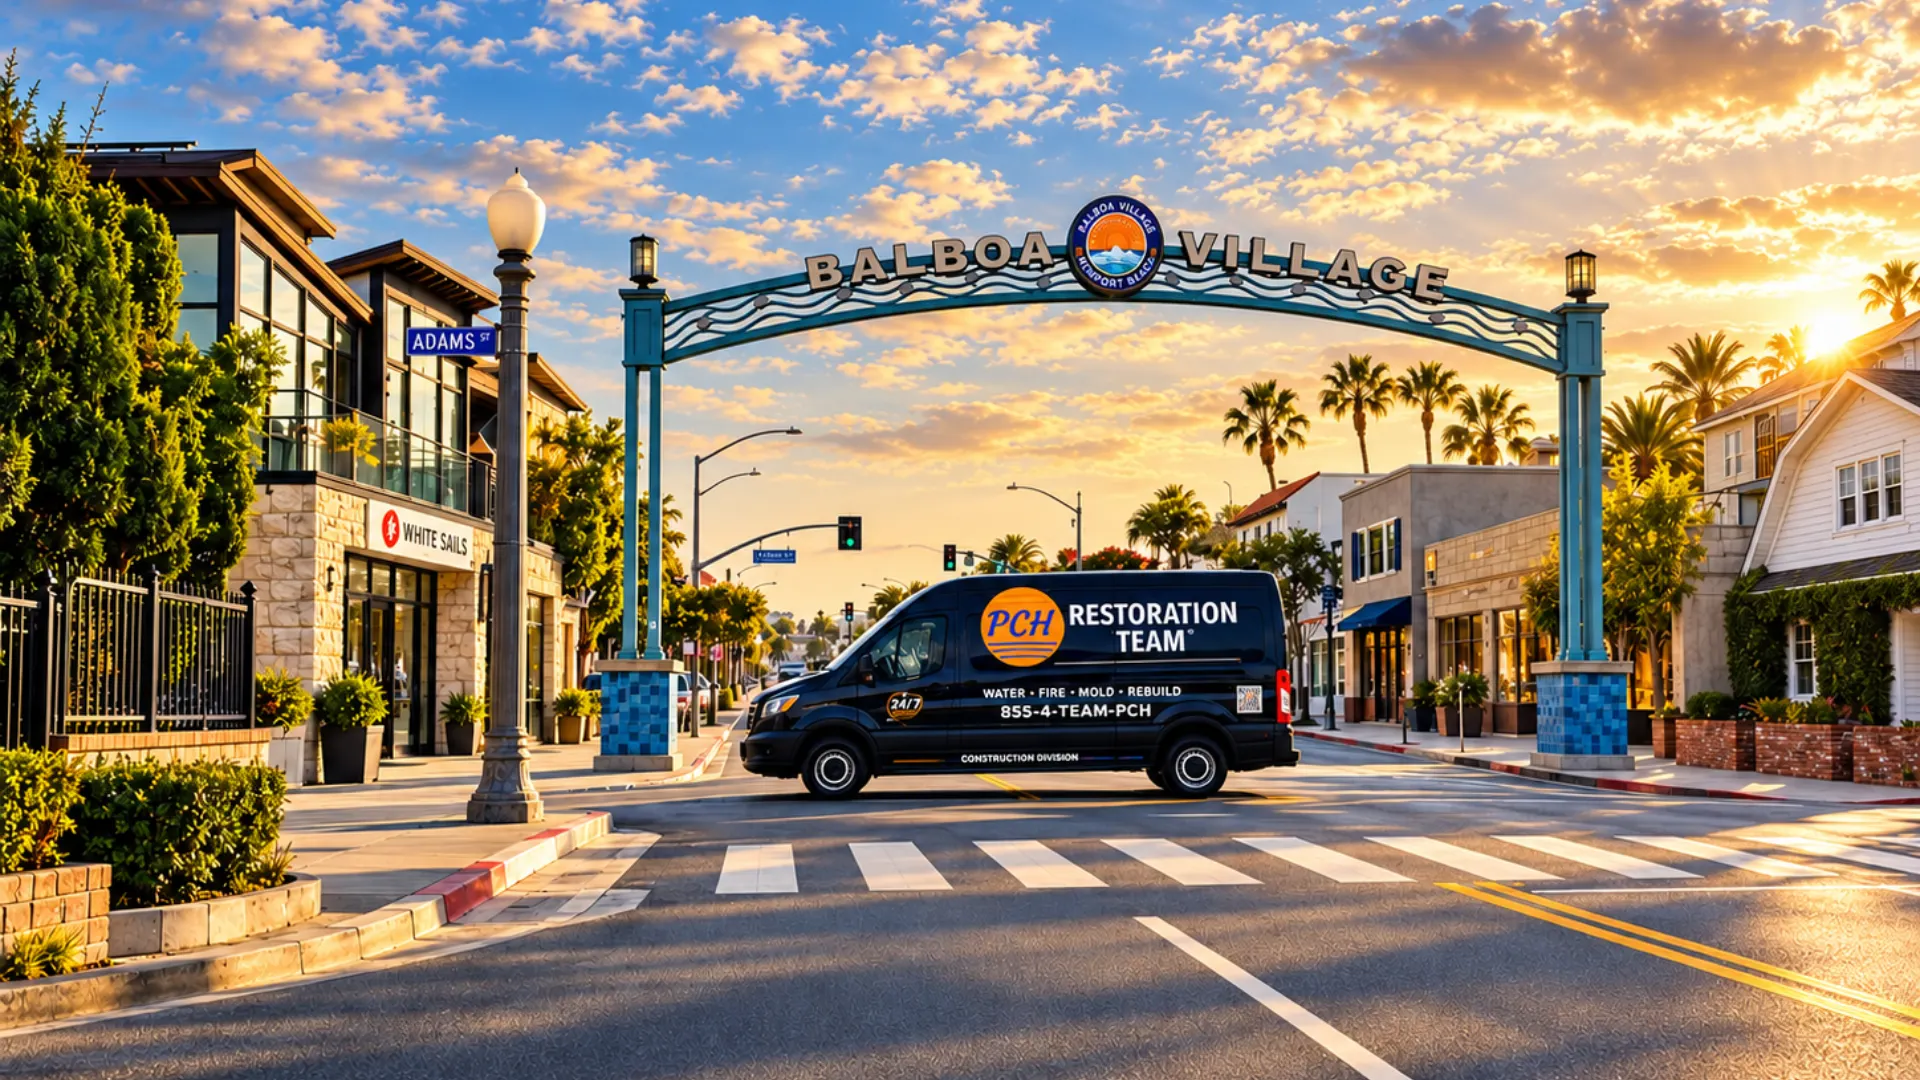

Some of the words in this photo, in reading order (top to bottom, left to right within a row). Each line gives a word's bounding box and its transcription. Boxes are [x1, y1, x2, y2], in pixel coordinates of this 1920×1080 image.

[804, 231, 1054, 293] BALBOA
[1177, 230, 1451, 302] VILLAGE
[412, 332, 475, 351] ADAMS
[402, 521, 438, 549] WHITE
[440, 532, 468, 556] SAILS
[986, 609, 1056, 637] PCH
[1068, 601, 1238, 626] RESTORATION
[983, 687, 1026, 699] WATER
[1038, 687, 1066, 698] FIRE
[1078, 686, 1115, 698] MOLD
[1127, 685, 1182, 697] REBUILD
[890, 698, 921, 710] 24/7
[1000, 703, 1152, 719] 855-4-TEAM-PCH
[960, 753, 1035, 763] CONSTRUCTION
[1036, 752, 1080, 762] DIVISION
